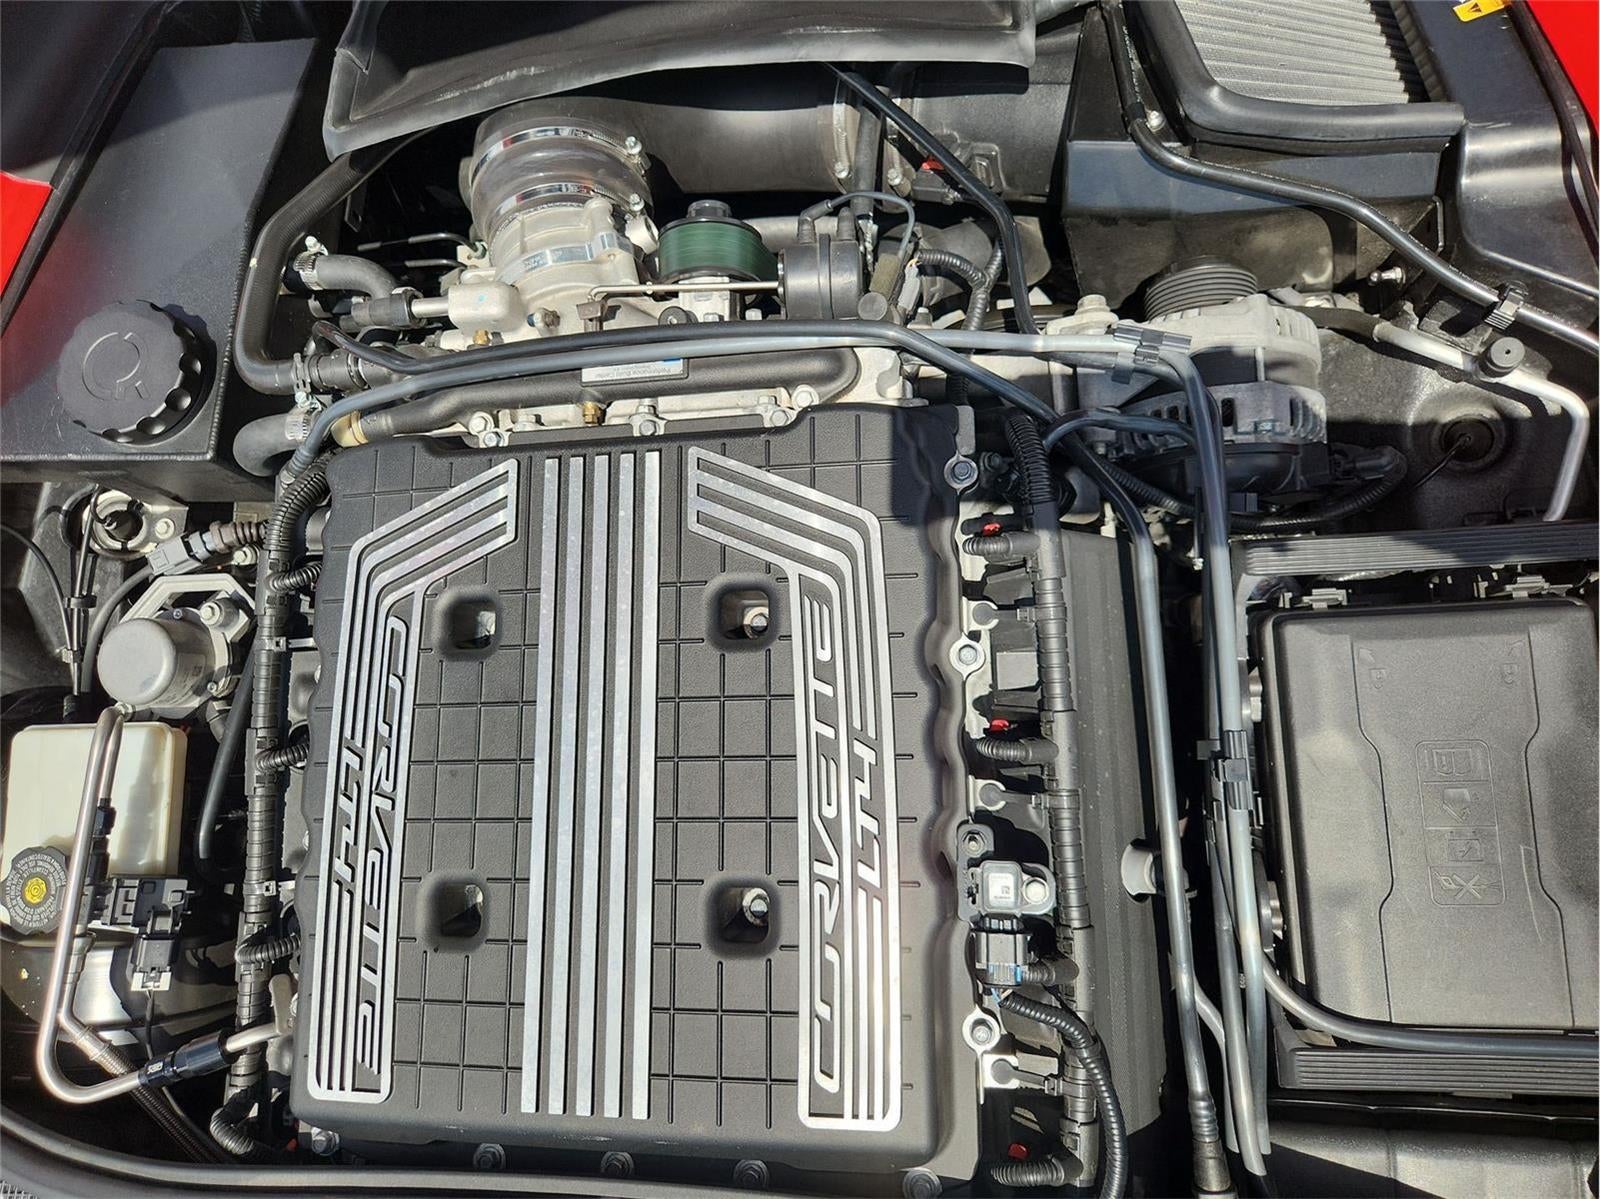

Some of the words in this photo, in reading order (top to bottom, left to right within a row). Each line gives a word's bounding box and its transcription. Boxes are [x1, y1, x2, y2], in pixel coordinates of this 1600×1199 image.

[334, 747, 363, 882] LT4
[357, 616, 408, 1074] CORVETTE
[804, 594, 841, 1093] CORVETTE
[854, 738, 880, 888] LT4
